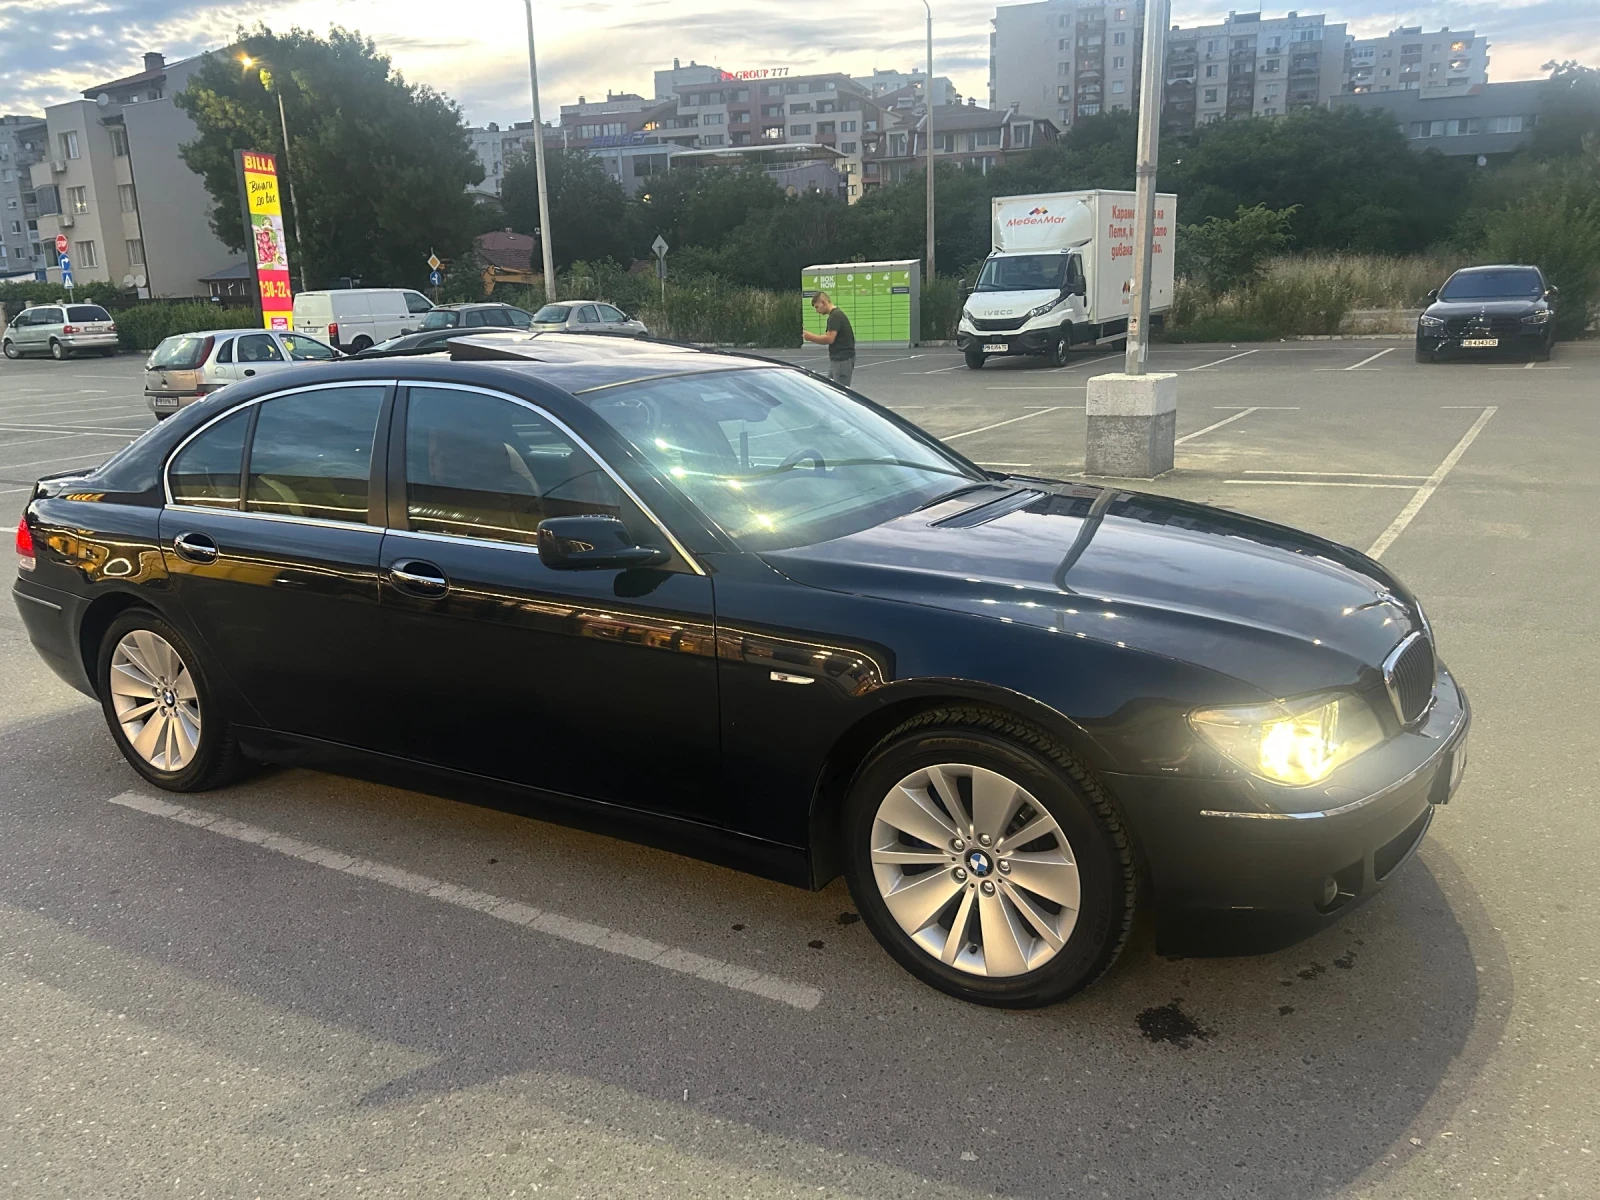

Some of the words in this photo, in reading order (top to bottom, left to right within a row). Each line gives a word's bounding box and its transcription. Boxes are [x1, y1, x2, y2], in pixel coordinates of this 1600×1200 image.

[736, 69, 769, 81] GROUP
[771, 67, 789, 77] 777
[244, 155, 275, 173] BILLA
[1006, 216, 1066, 227] МебелМаг
[820, 275, 834, 283] BOX
